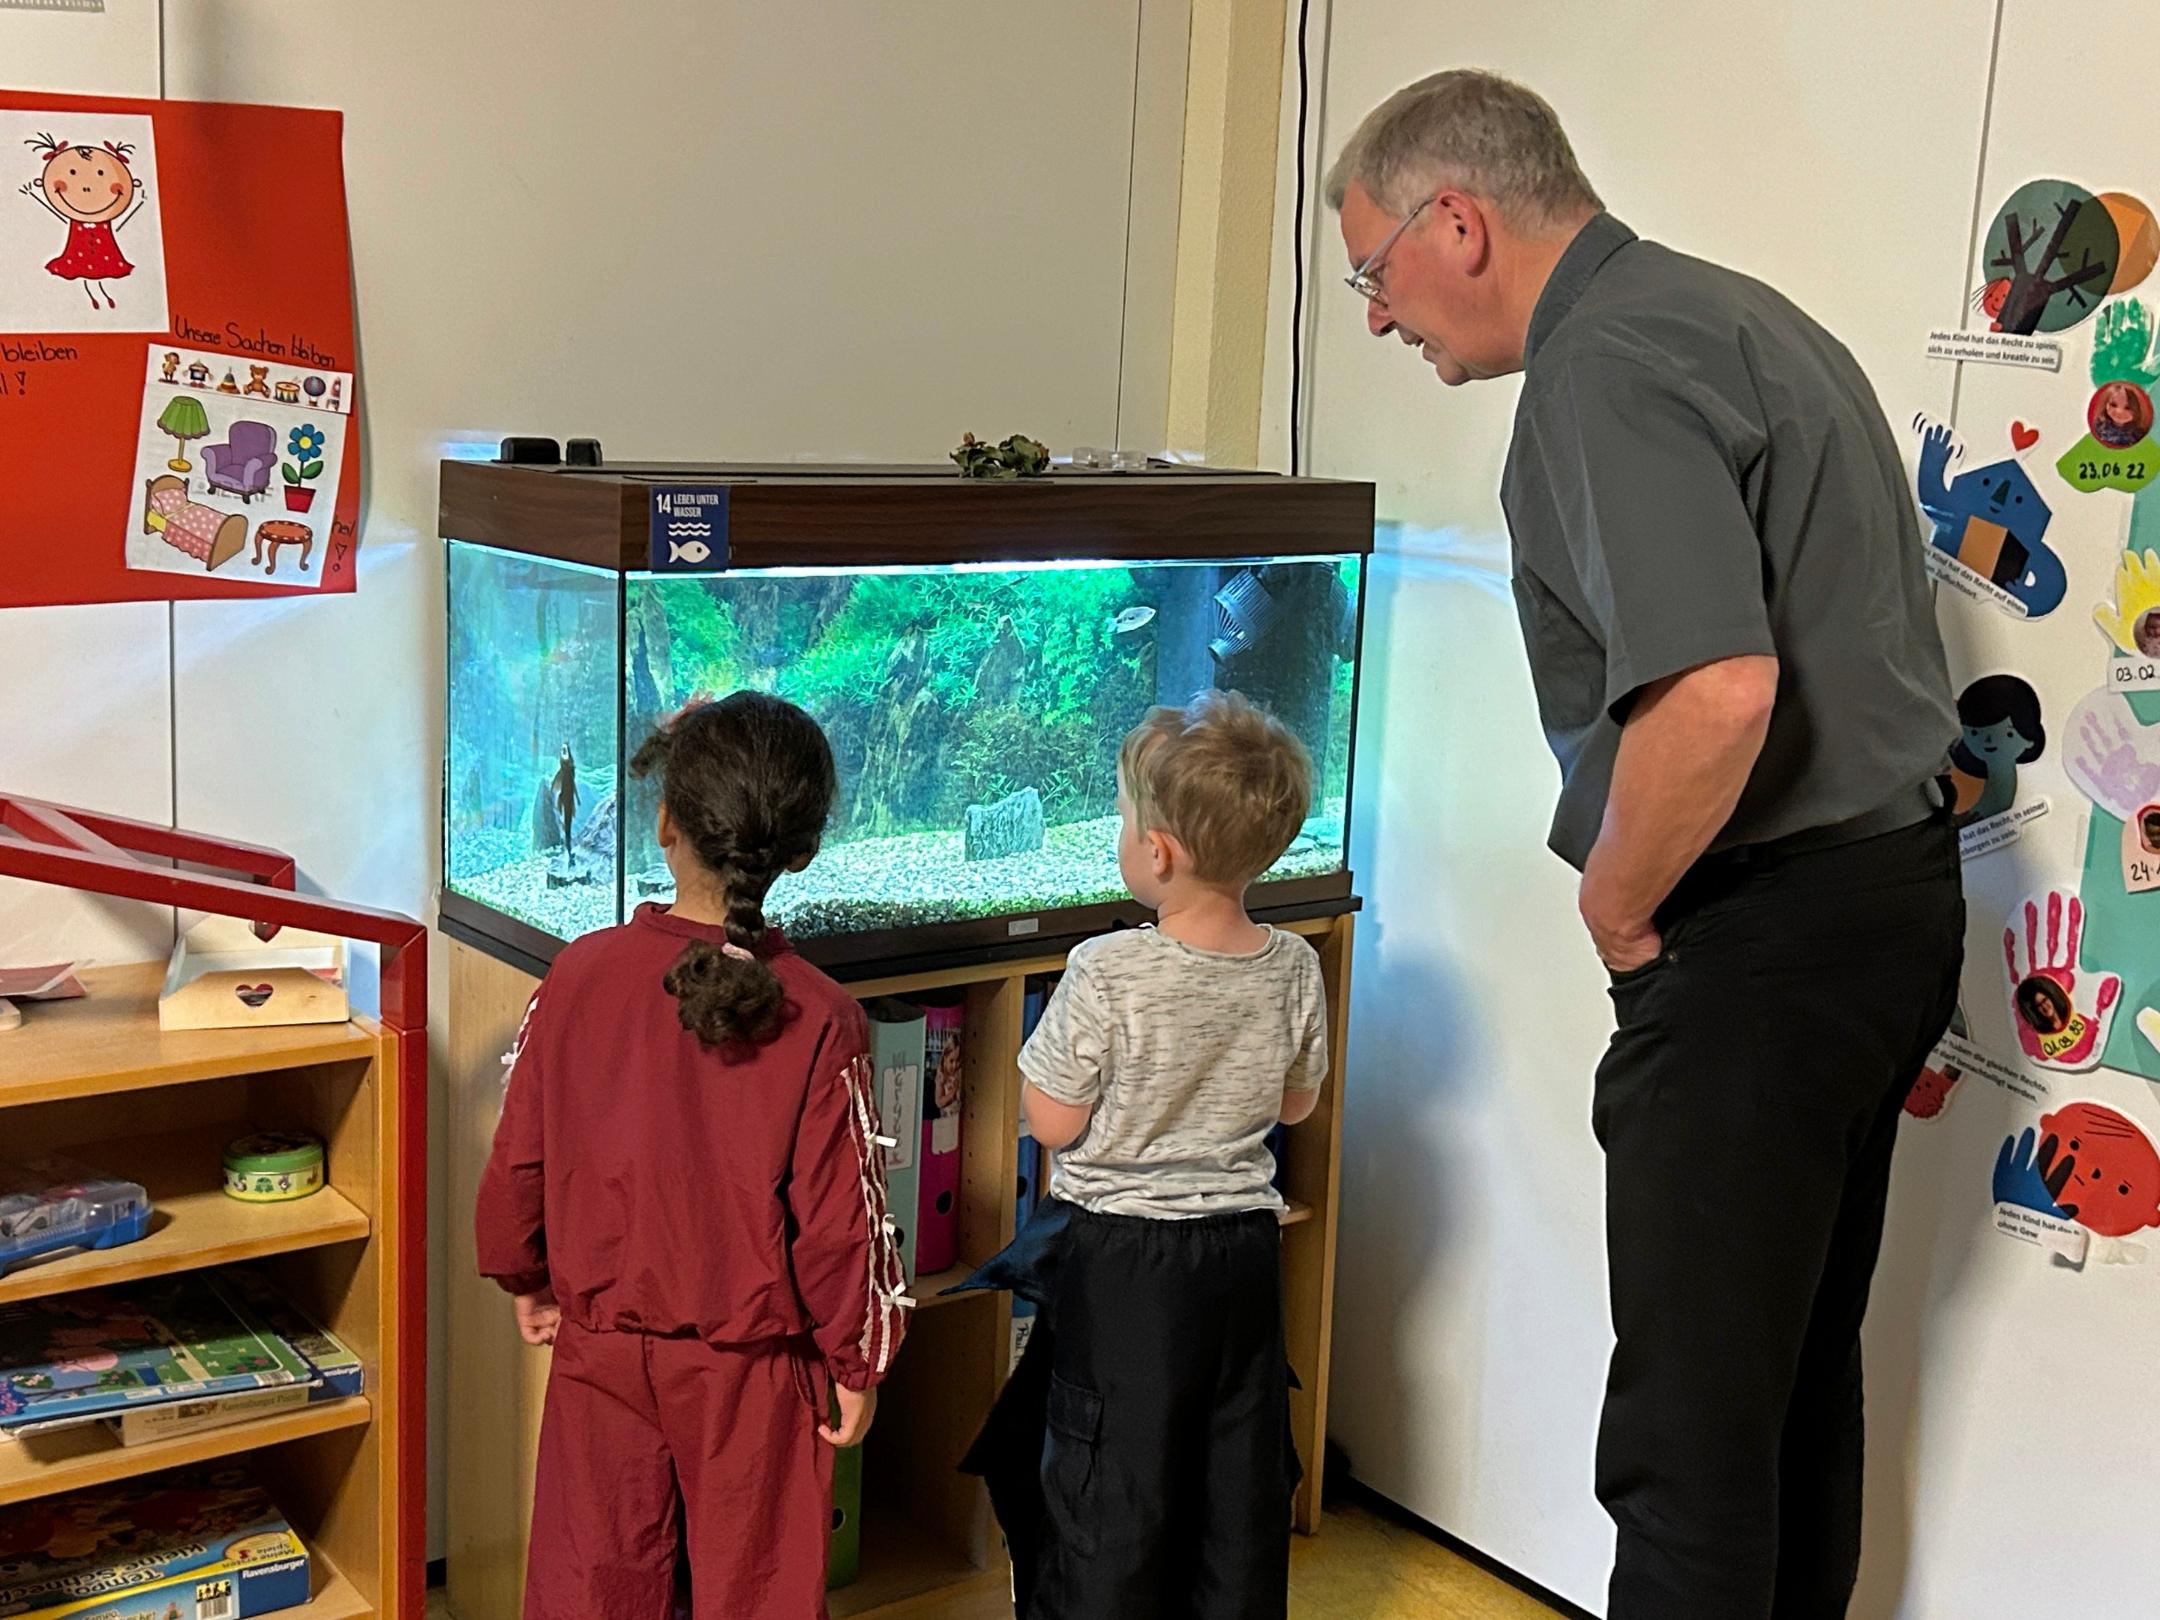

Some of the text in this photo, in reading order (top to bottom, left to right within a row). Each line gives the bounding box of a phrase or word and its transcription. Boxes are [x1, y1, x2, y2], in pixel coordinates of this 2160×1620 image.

[175, 315, 336, 369] Unsere Sachen bleiben
[1930, 331, 1951, 341] Jedes
[1952, 333, 1970, 341] Kind
[1971, 335, 1984, 344] hat
[1985, 336, 1999, 345] das
[2000, 338, 2023, 348] Recht
[2024, 341, 2034, 349] zu
[1, 340, 78, 362] bleiben
[1928, 345, 1943, 354] sich
[1944, 347, 1953, 355] zu
[1954, 347, 1984, 357] erholen
[1985, 350, 2001, 359] und
[2002, 352, 2030, 362] kreativ
[2031, 355, 2040, 363] zu
[2127, 462, 2145, 480] 22
[656, 493, 719, 514] 14 LEBEN UNTER
[673, 506, 702, 518] WASSER
[1948, 560, 1960, 574] hat
[1960, 569, 1973, 582] das
[1974, 576, 1994, 595] Recht
[1994, 590, 2008, 604] auf
[1962, 830, 1976, 842] hat
[1977, 826, 1990, 837] das
[2014, 810, 2022, 820] in
[2023, 802, 2045, 818] seiner
[1991, 837, 2000, 846] zu
[1973, 1052, 1986, 1063] die
[1986, 1059, 2019, 1079] gleichen
[1997, 1220, 2019, 1232] ohne
[1999, 1207, 2021, 1221] Jedes
[2022, 1213, 2041, 1226] Kind
[2042, 1220, 2057, 1231] hat
[126, 1543, 207, 1573] kleine
[242, 1559, 305, 1579] Ravensburger
